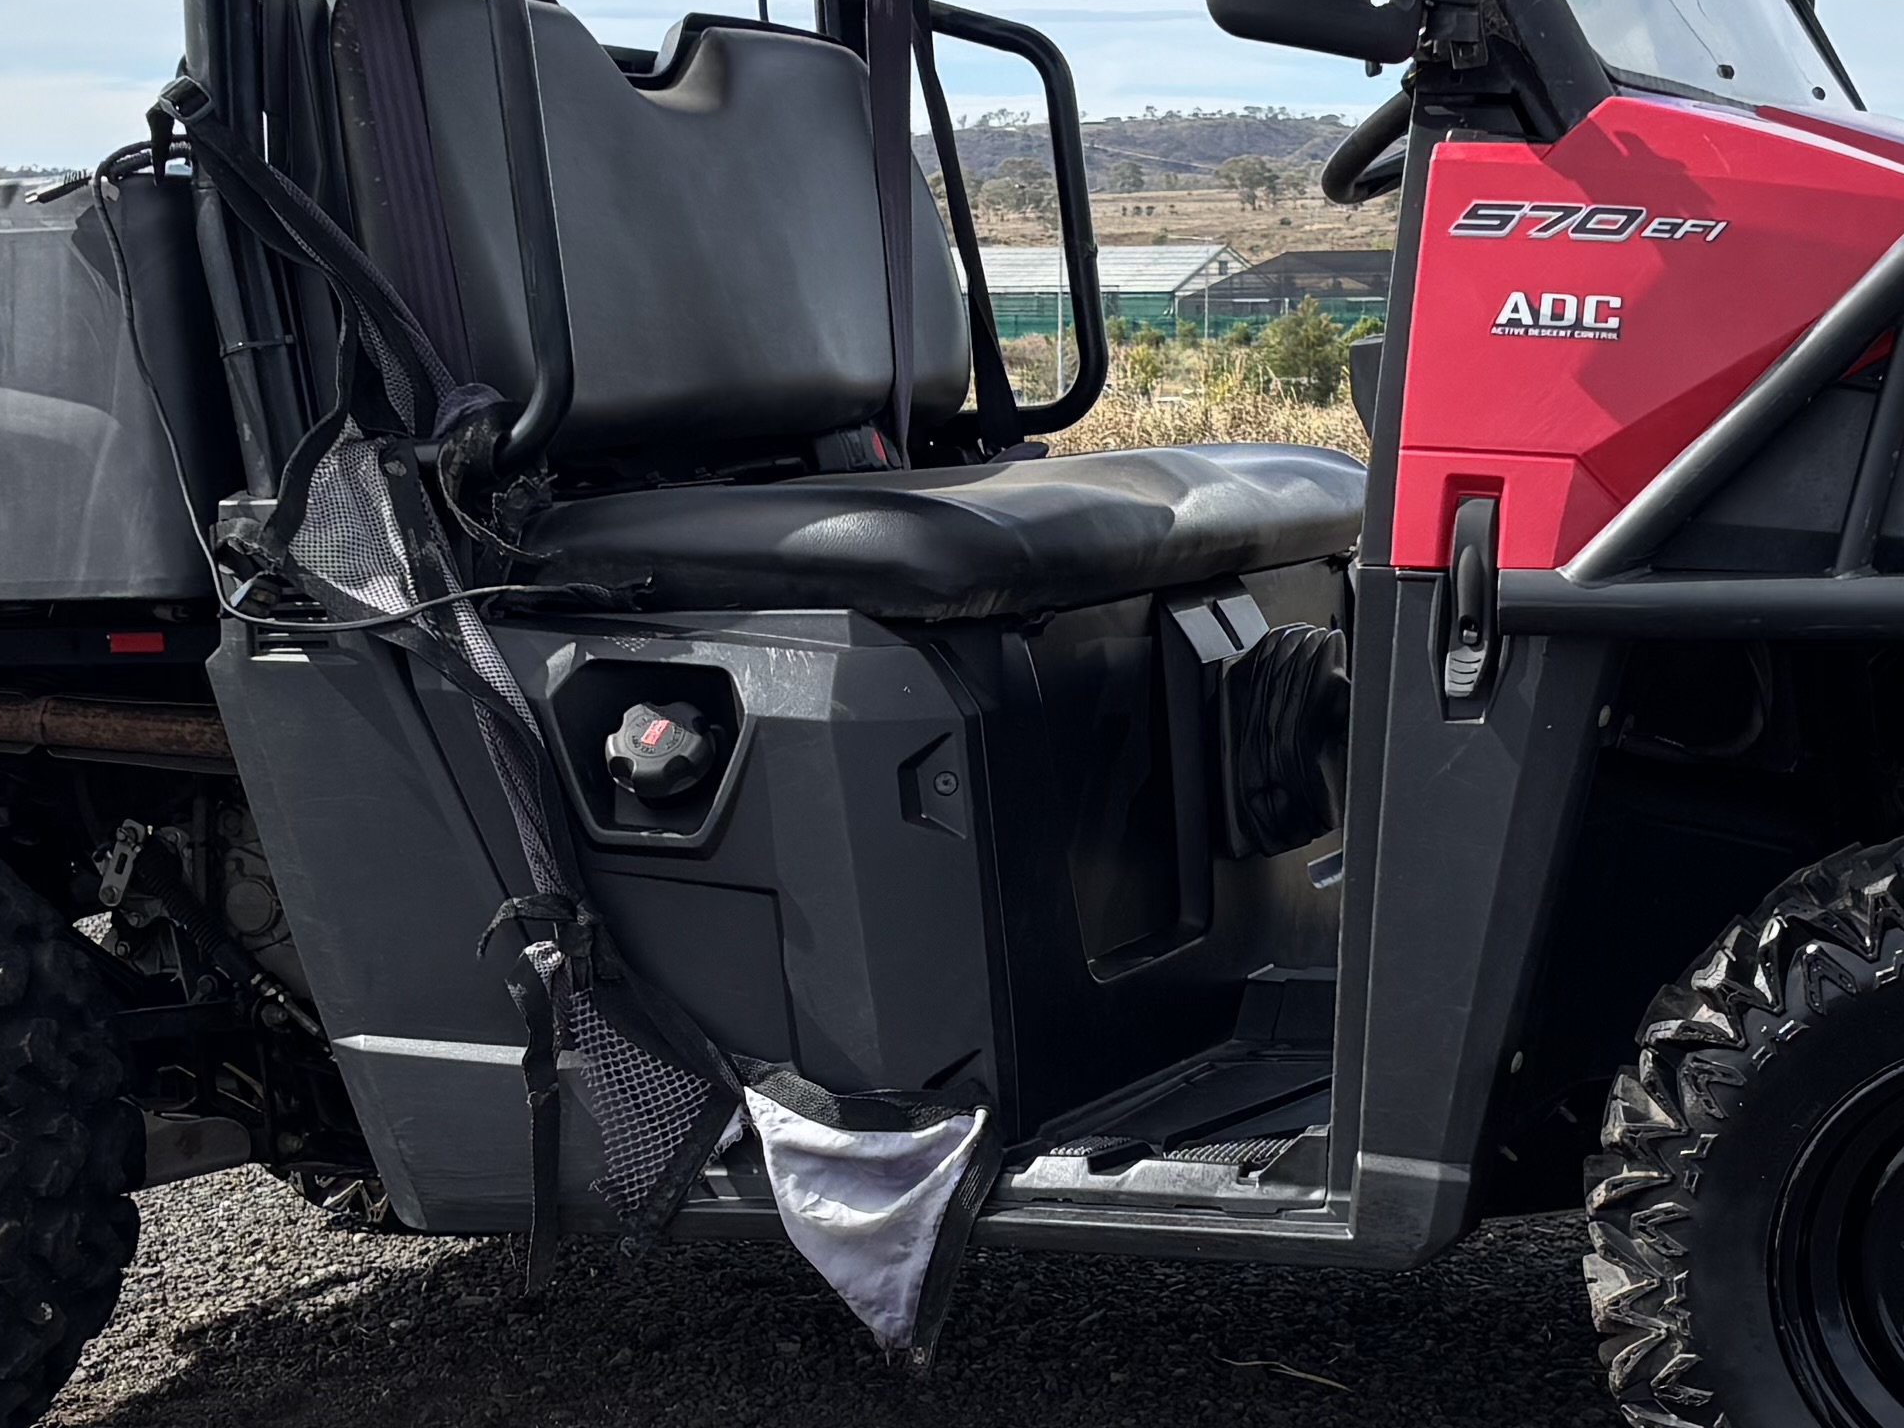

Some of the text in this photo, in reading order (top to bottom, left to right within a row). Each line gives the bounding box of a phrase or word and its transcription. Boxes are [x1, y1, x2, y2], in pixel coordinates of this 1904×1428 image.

[1448, 200, 1729, 242] 570 EFI
[1495, 291, 1622, 329] ADC
[1490, 326, 1619, 341] ACTIVE DESCENT CONTROL
